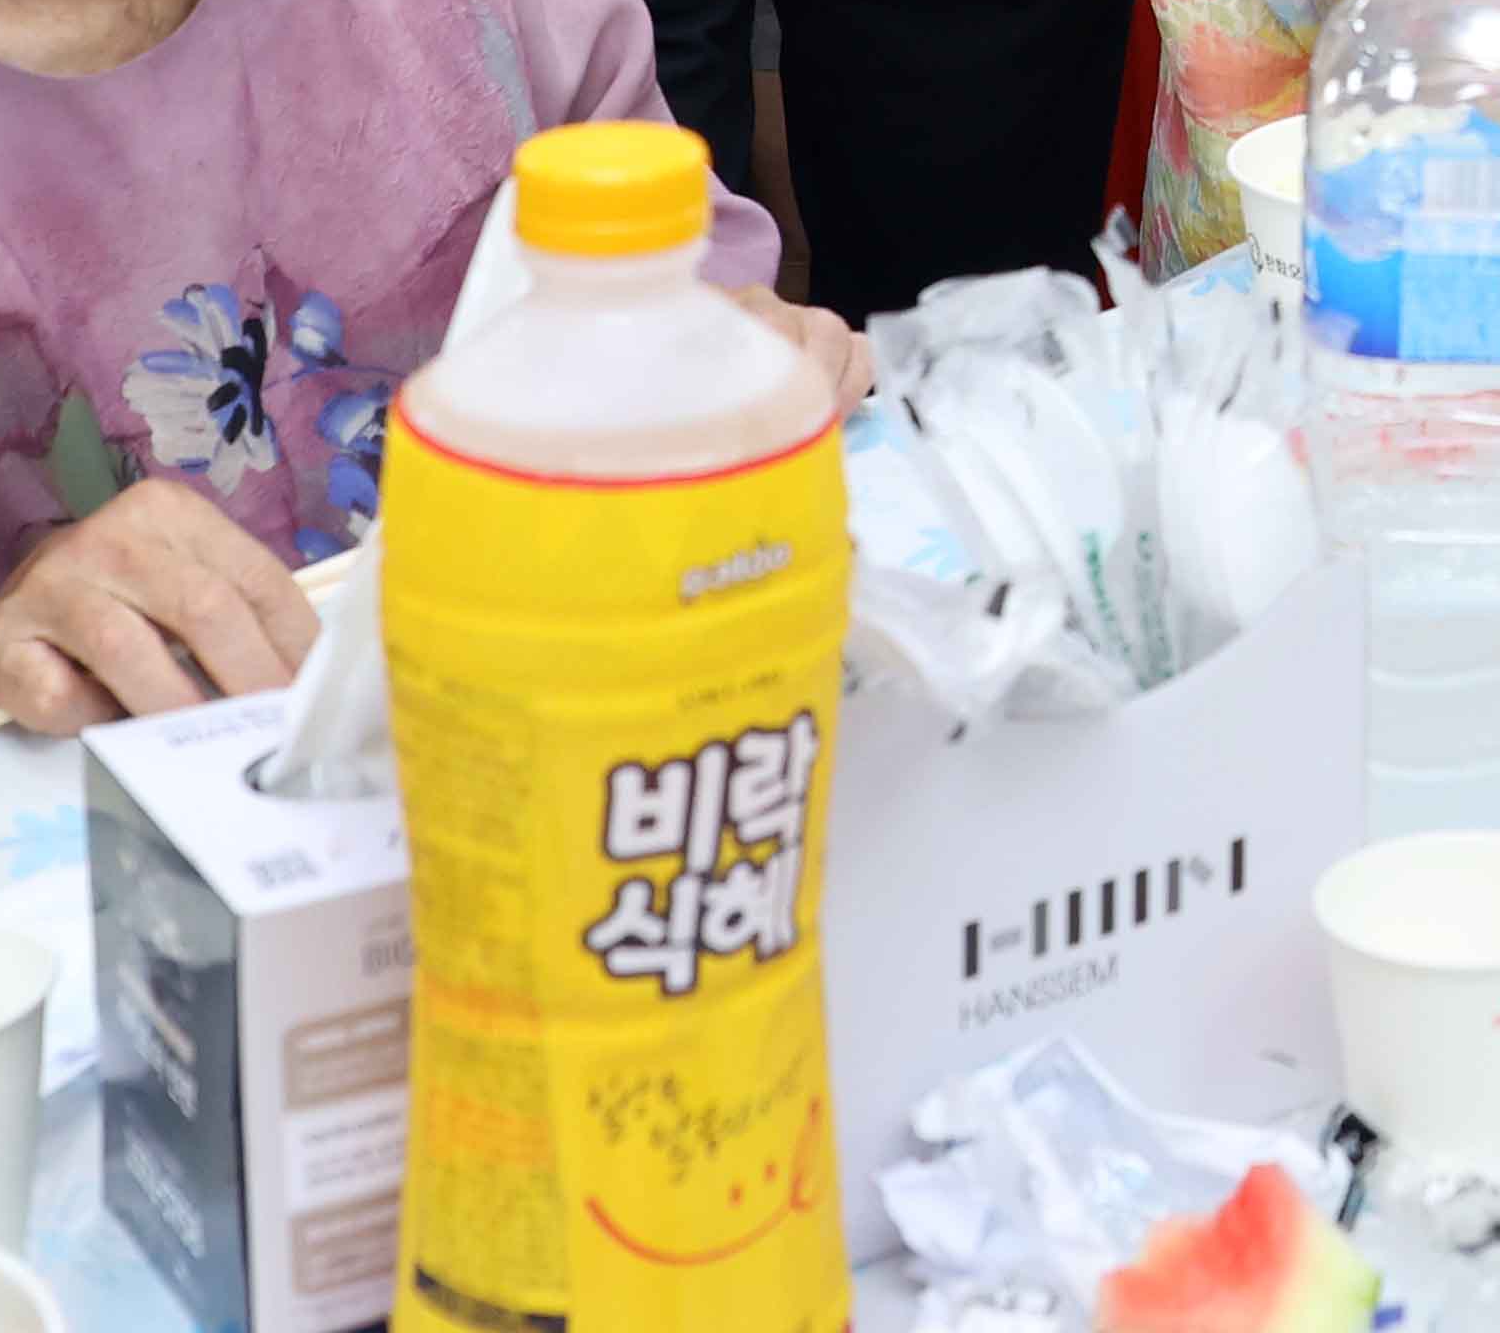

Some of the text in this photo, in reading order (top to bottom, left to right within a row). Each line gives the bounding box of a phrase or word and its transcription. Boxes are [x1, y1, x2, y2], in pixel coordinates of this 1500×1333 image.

[604, 708, 821, 874] 비락
[583, 844, 802, 997] 식혜
[958, 951, 1119, 1031] HANSSEM
